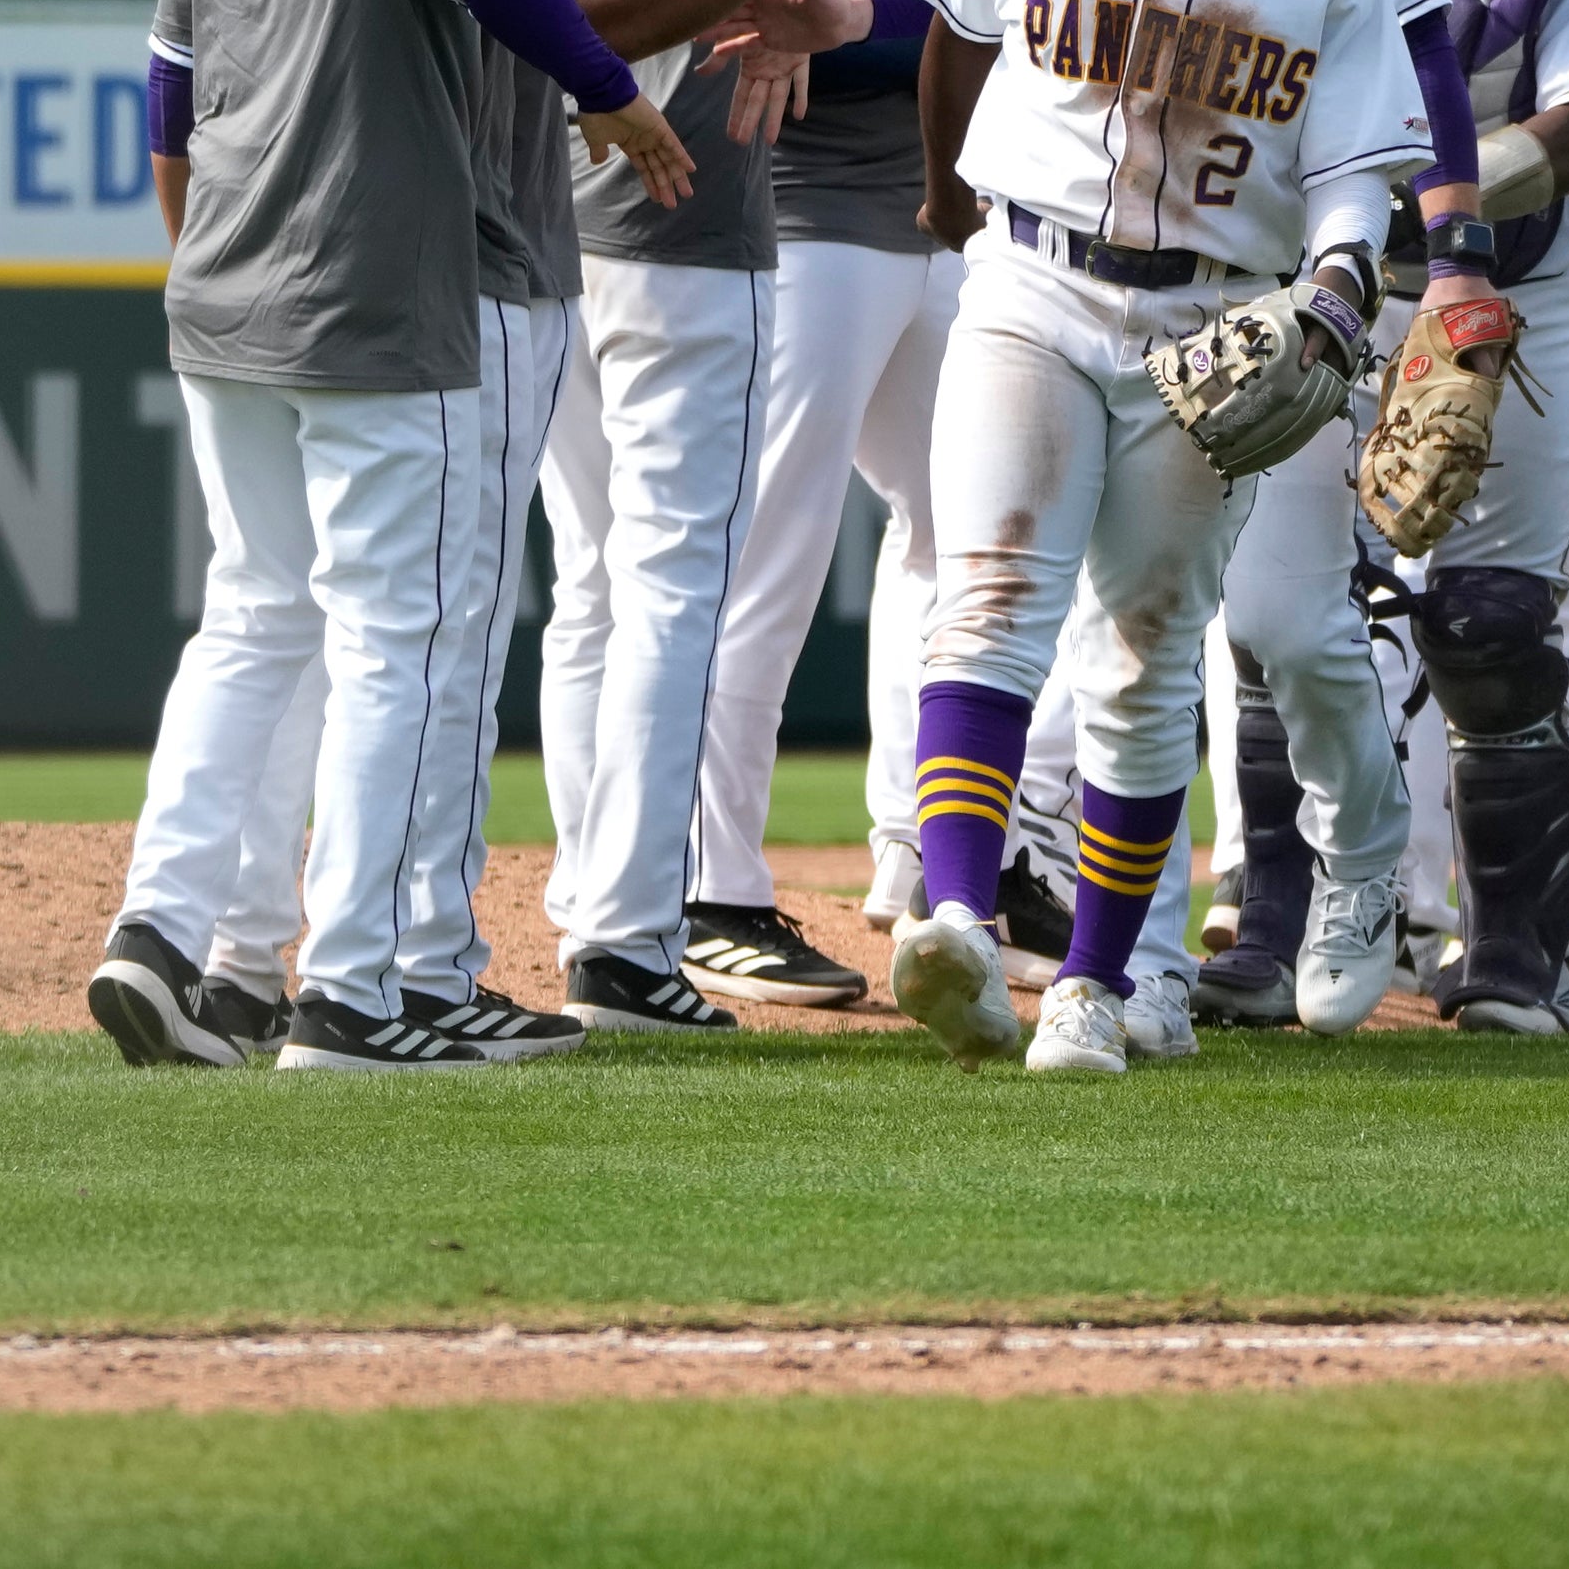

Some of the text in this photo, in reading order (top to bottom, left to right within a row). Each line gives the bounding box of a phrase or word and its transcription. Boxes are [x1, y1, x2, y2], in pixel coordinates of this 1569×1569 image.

[1194, 134, 1254, 207] 2
[1316, 300, 1357, 330] Rawlings
[1452, 311, 1498, 336] Rawlings
